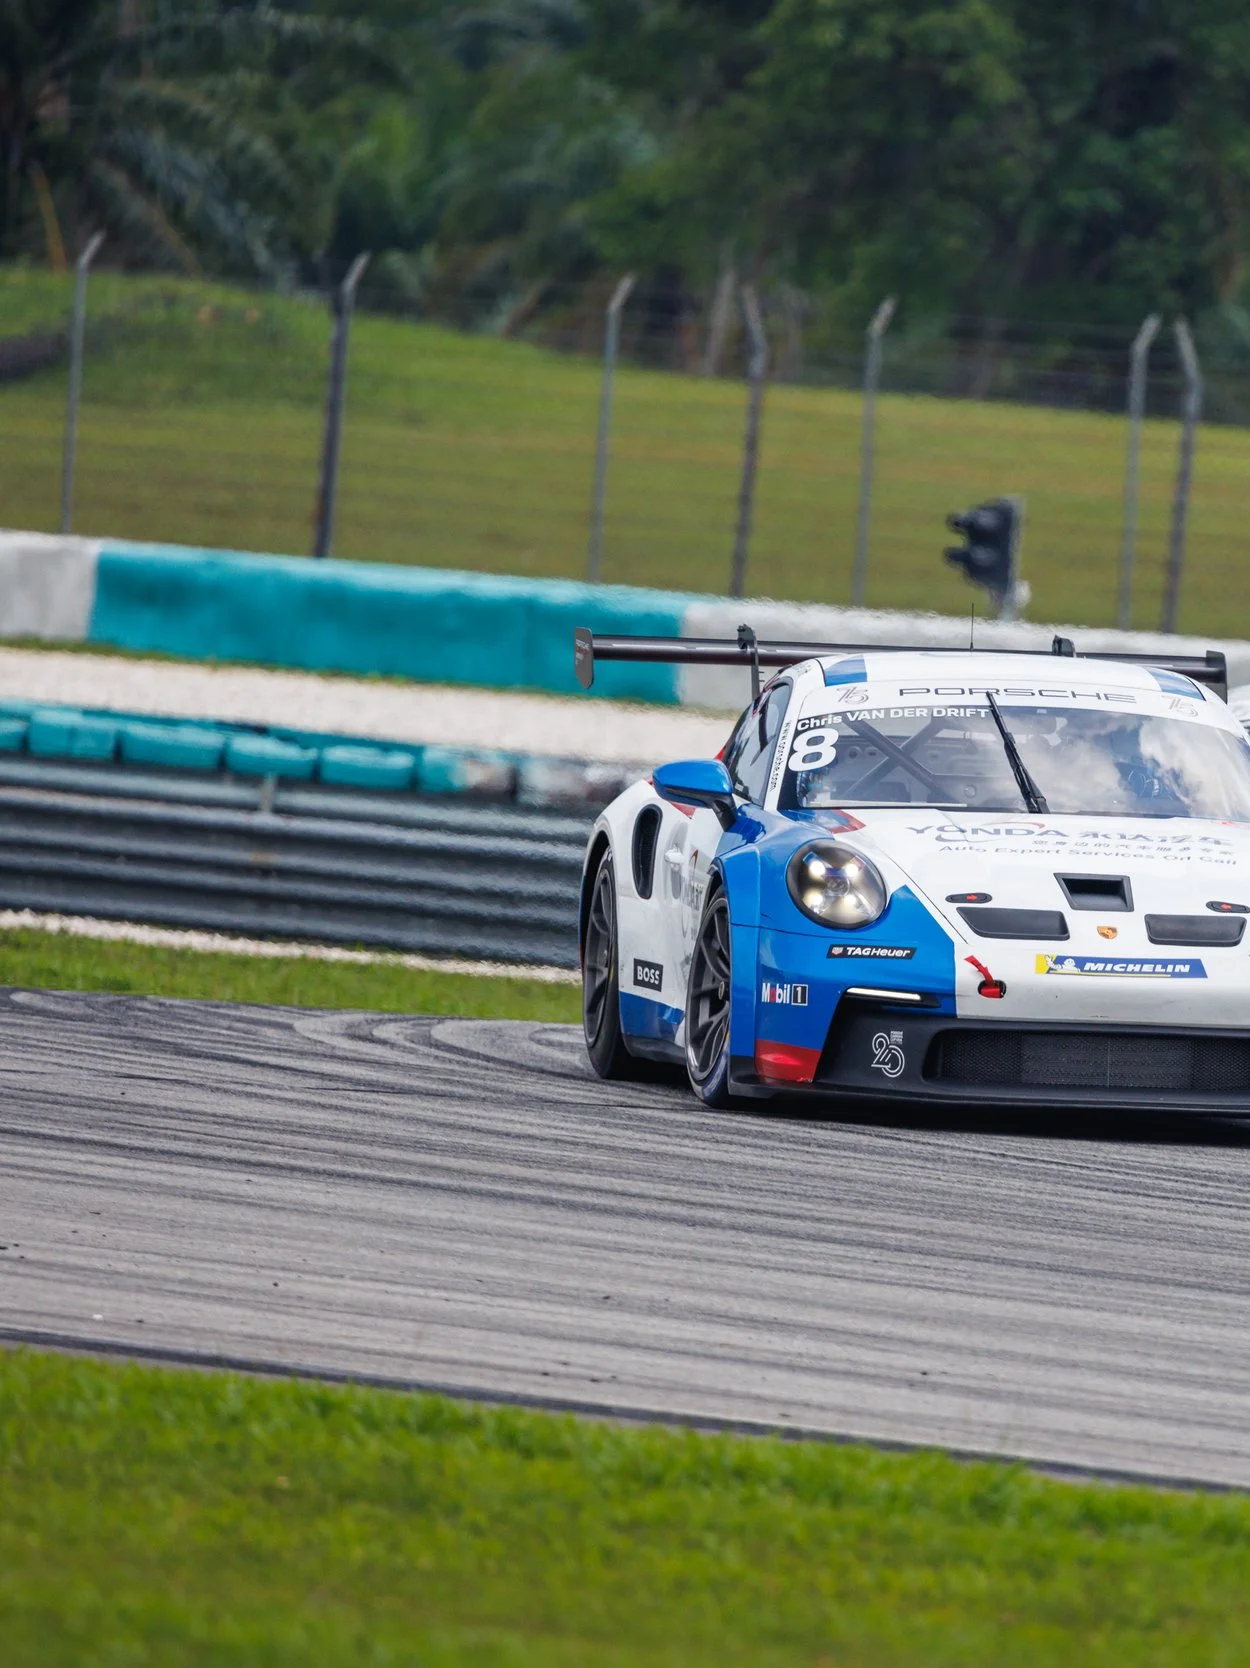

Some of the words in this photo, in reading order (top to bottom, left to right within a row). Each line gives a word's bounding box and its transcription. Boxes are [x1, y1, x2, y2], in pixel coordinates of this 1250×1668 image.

[899, 687, 1137, 704] PORSCHE
[797, 714, 843, 731] Chris
[846, 709, 885, 722] VAN
[890, 708, 928, 718] DER
[933, 707, 990, 718] DRIFT
[788, 727, 839, 772] 8
[906, 824, 1069, 838] YONDA
[939, 845, 987, 853] Auto
[994, 847, 1061, 855] Expert
[1068, 849, 1155, 860] Services
[1199, 855, 1237, 866] Call
[636, 965, 660, 985] BOSS
[1083, 962, 1191, 973] MICHELIN
[761, 982, 791, 1004] Mobil
